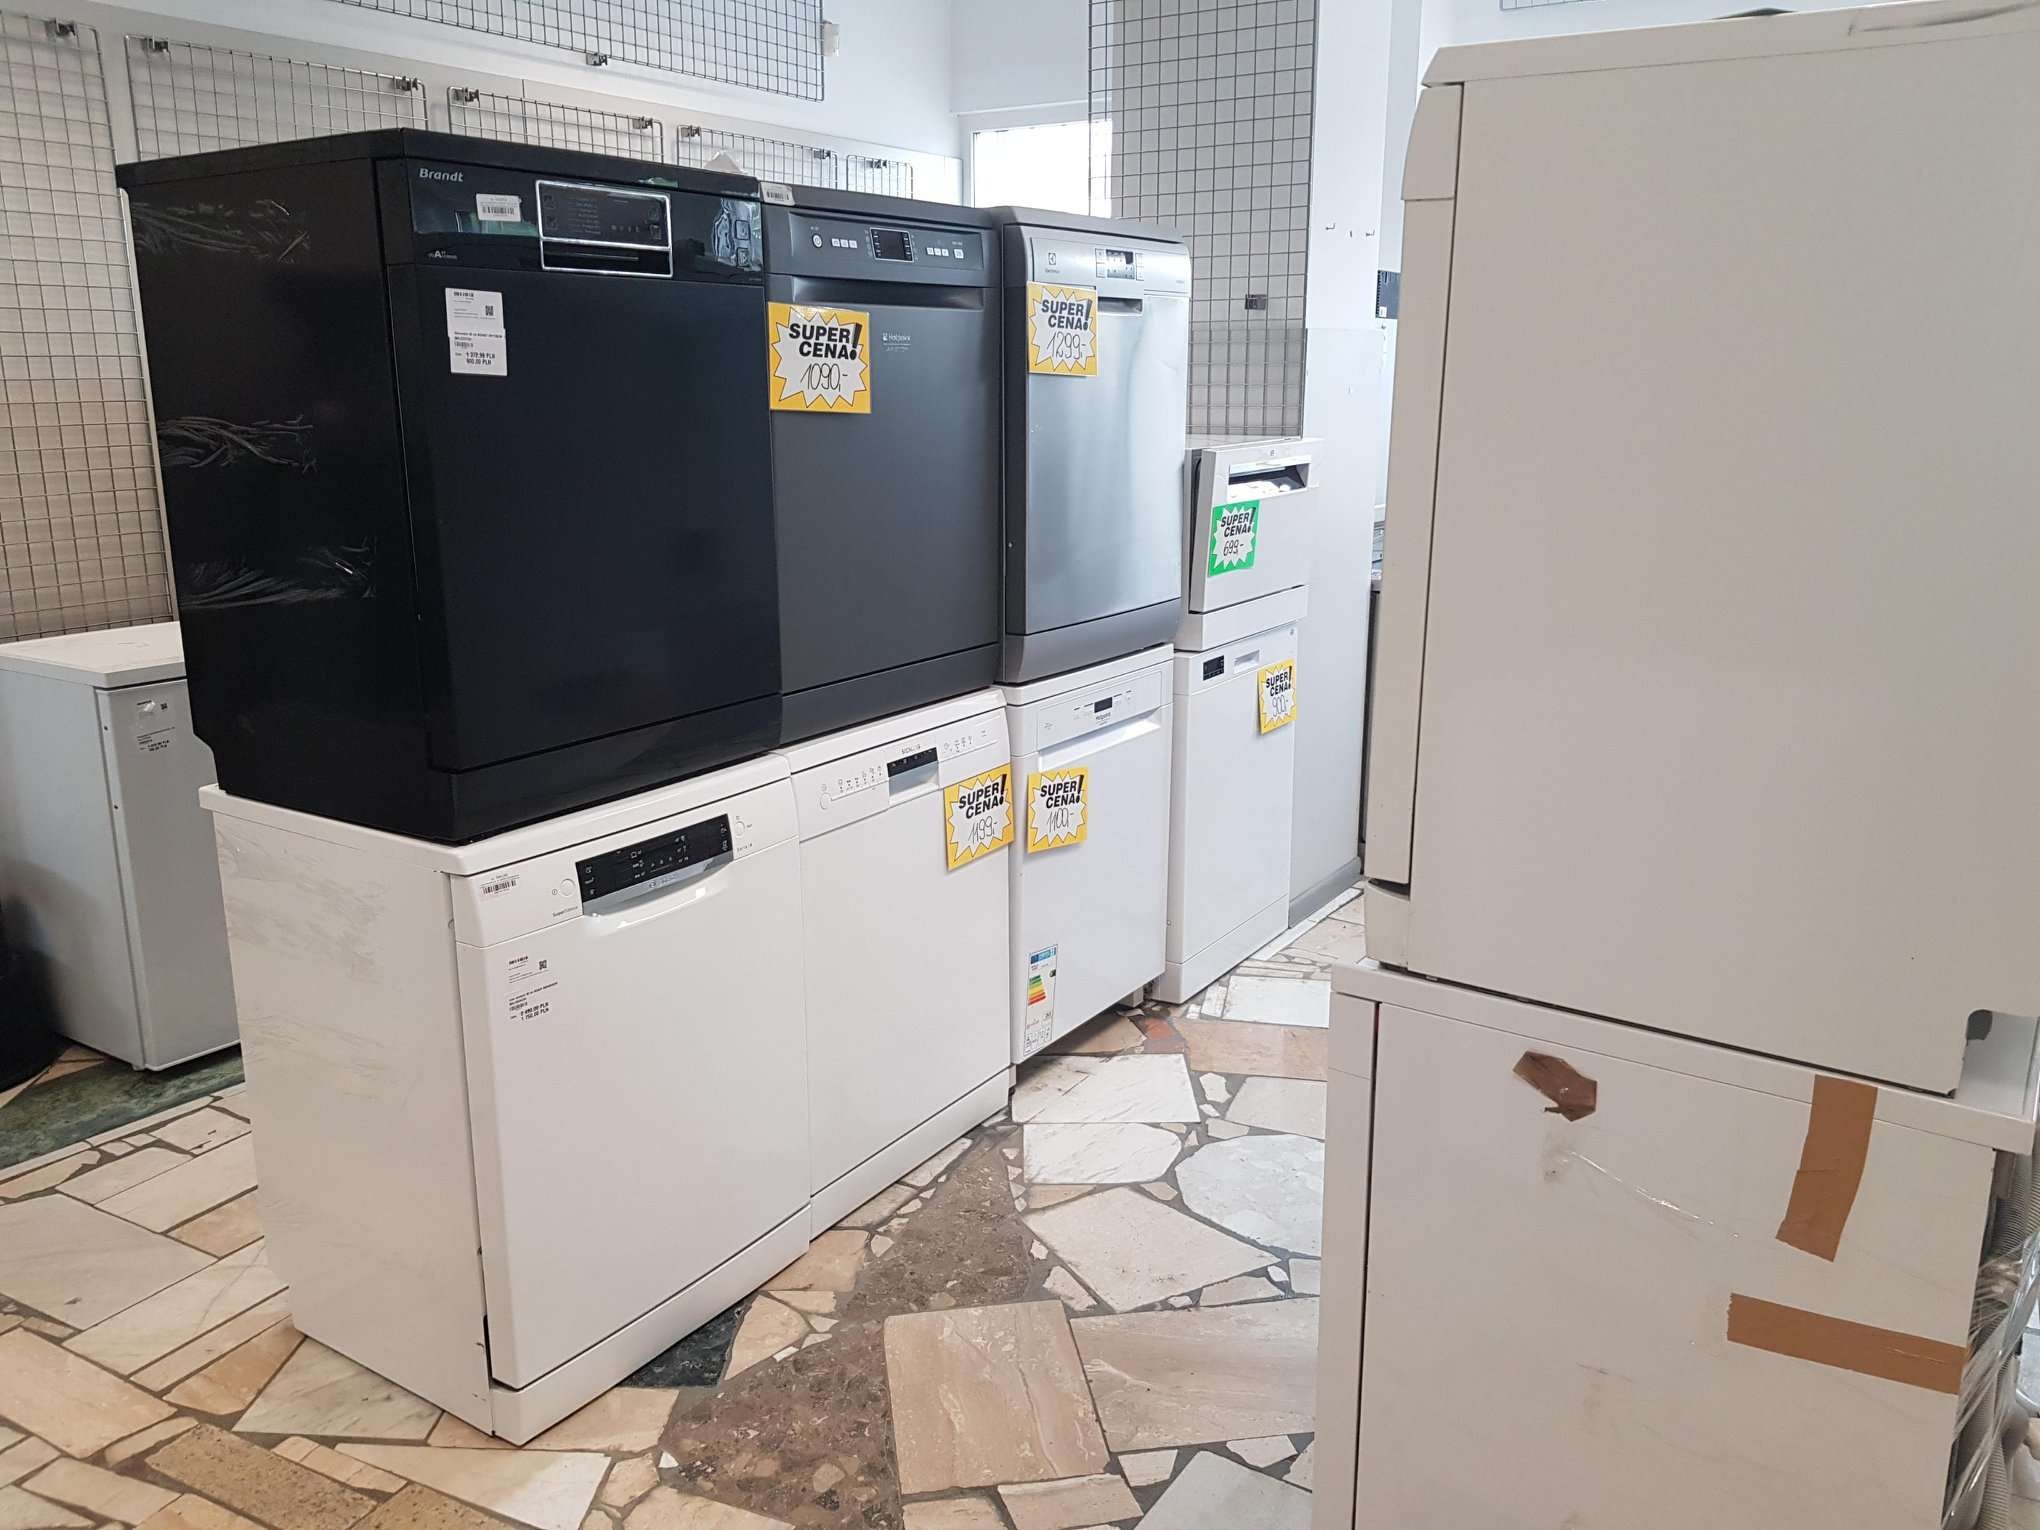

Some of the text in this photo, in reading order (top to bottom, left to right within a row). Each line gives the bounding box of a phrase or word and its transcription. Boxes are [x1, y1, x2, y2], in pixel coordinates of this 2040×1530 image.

[419, 167, 464, 182] Brandt
[1041, 299, 1084, 317] SUPER
[789, 323, 851, 344] SUPER
[1220, 512, 1249, 527] SUPER
[1265, 671, 1289, 688] SUPER
[958, 784, 1000, 810] SUPER
[1040, 780, 1077, 797] SUPER
